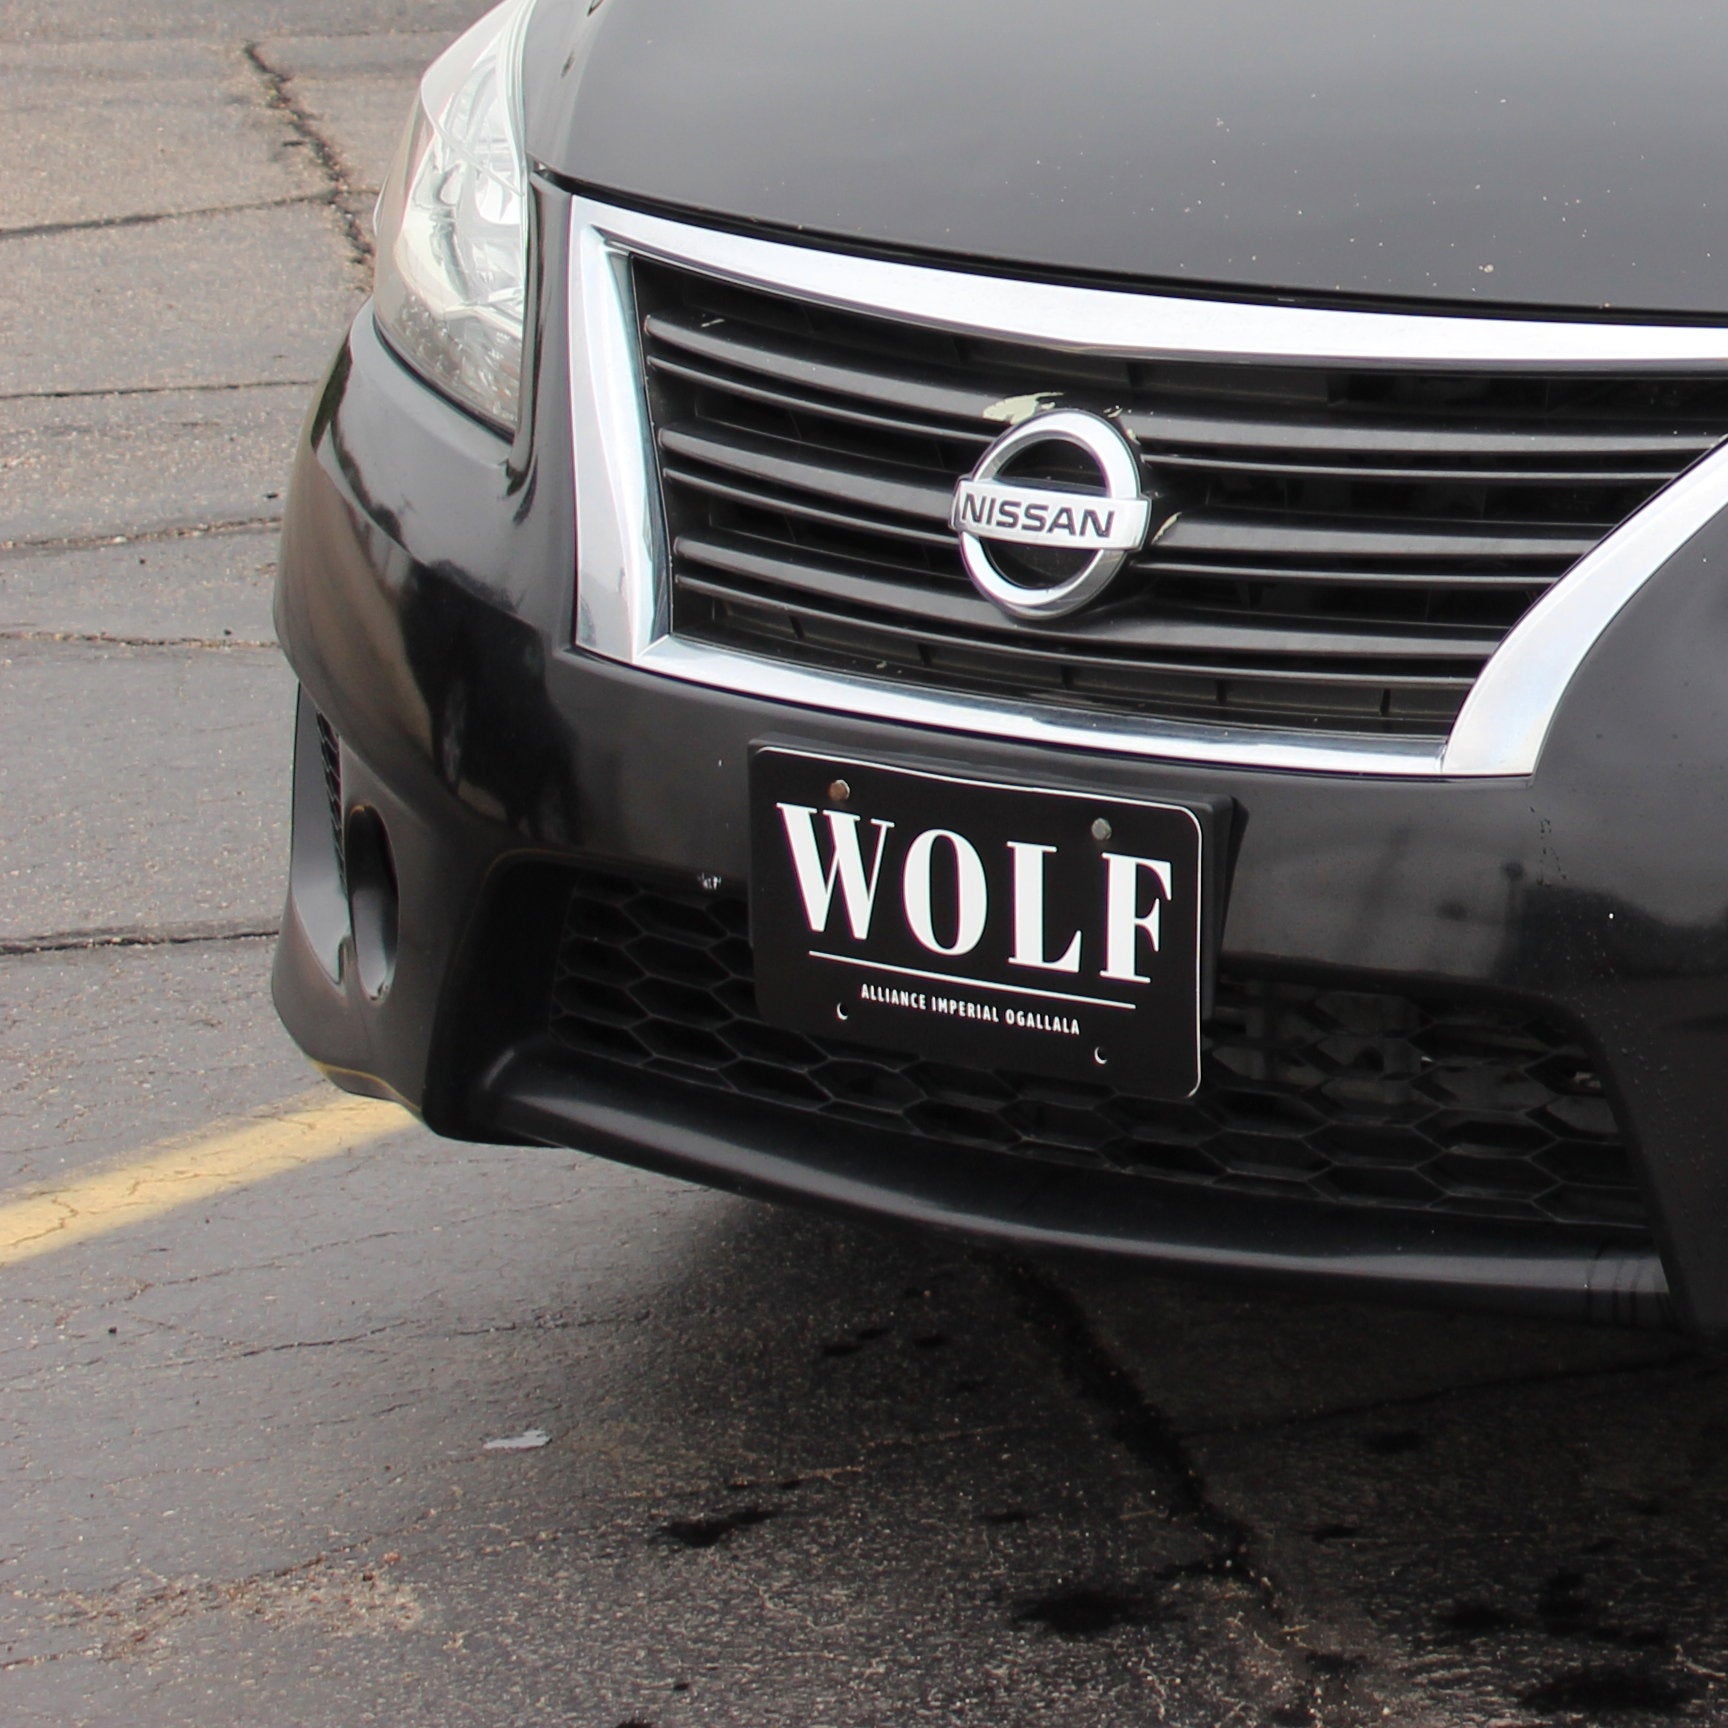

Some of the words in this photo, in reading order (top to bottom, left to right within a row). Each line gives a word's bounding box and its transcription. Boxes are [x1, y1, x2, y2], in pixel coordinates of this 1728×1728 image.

[961, 493, 1115, 538] NISSAN
[776, 802, 1172, 983] WOLF
[860, 984, 926, 1009] ALLIANCE
[931, 996, 999, 1022] IMPERIAL
[1005, 1009, 1080, 1035] OGALLALA
